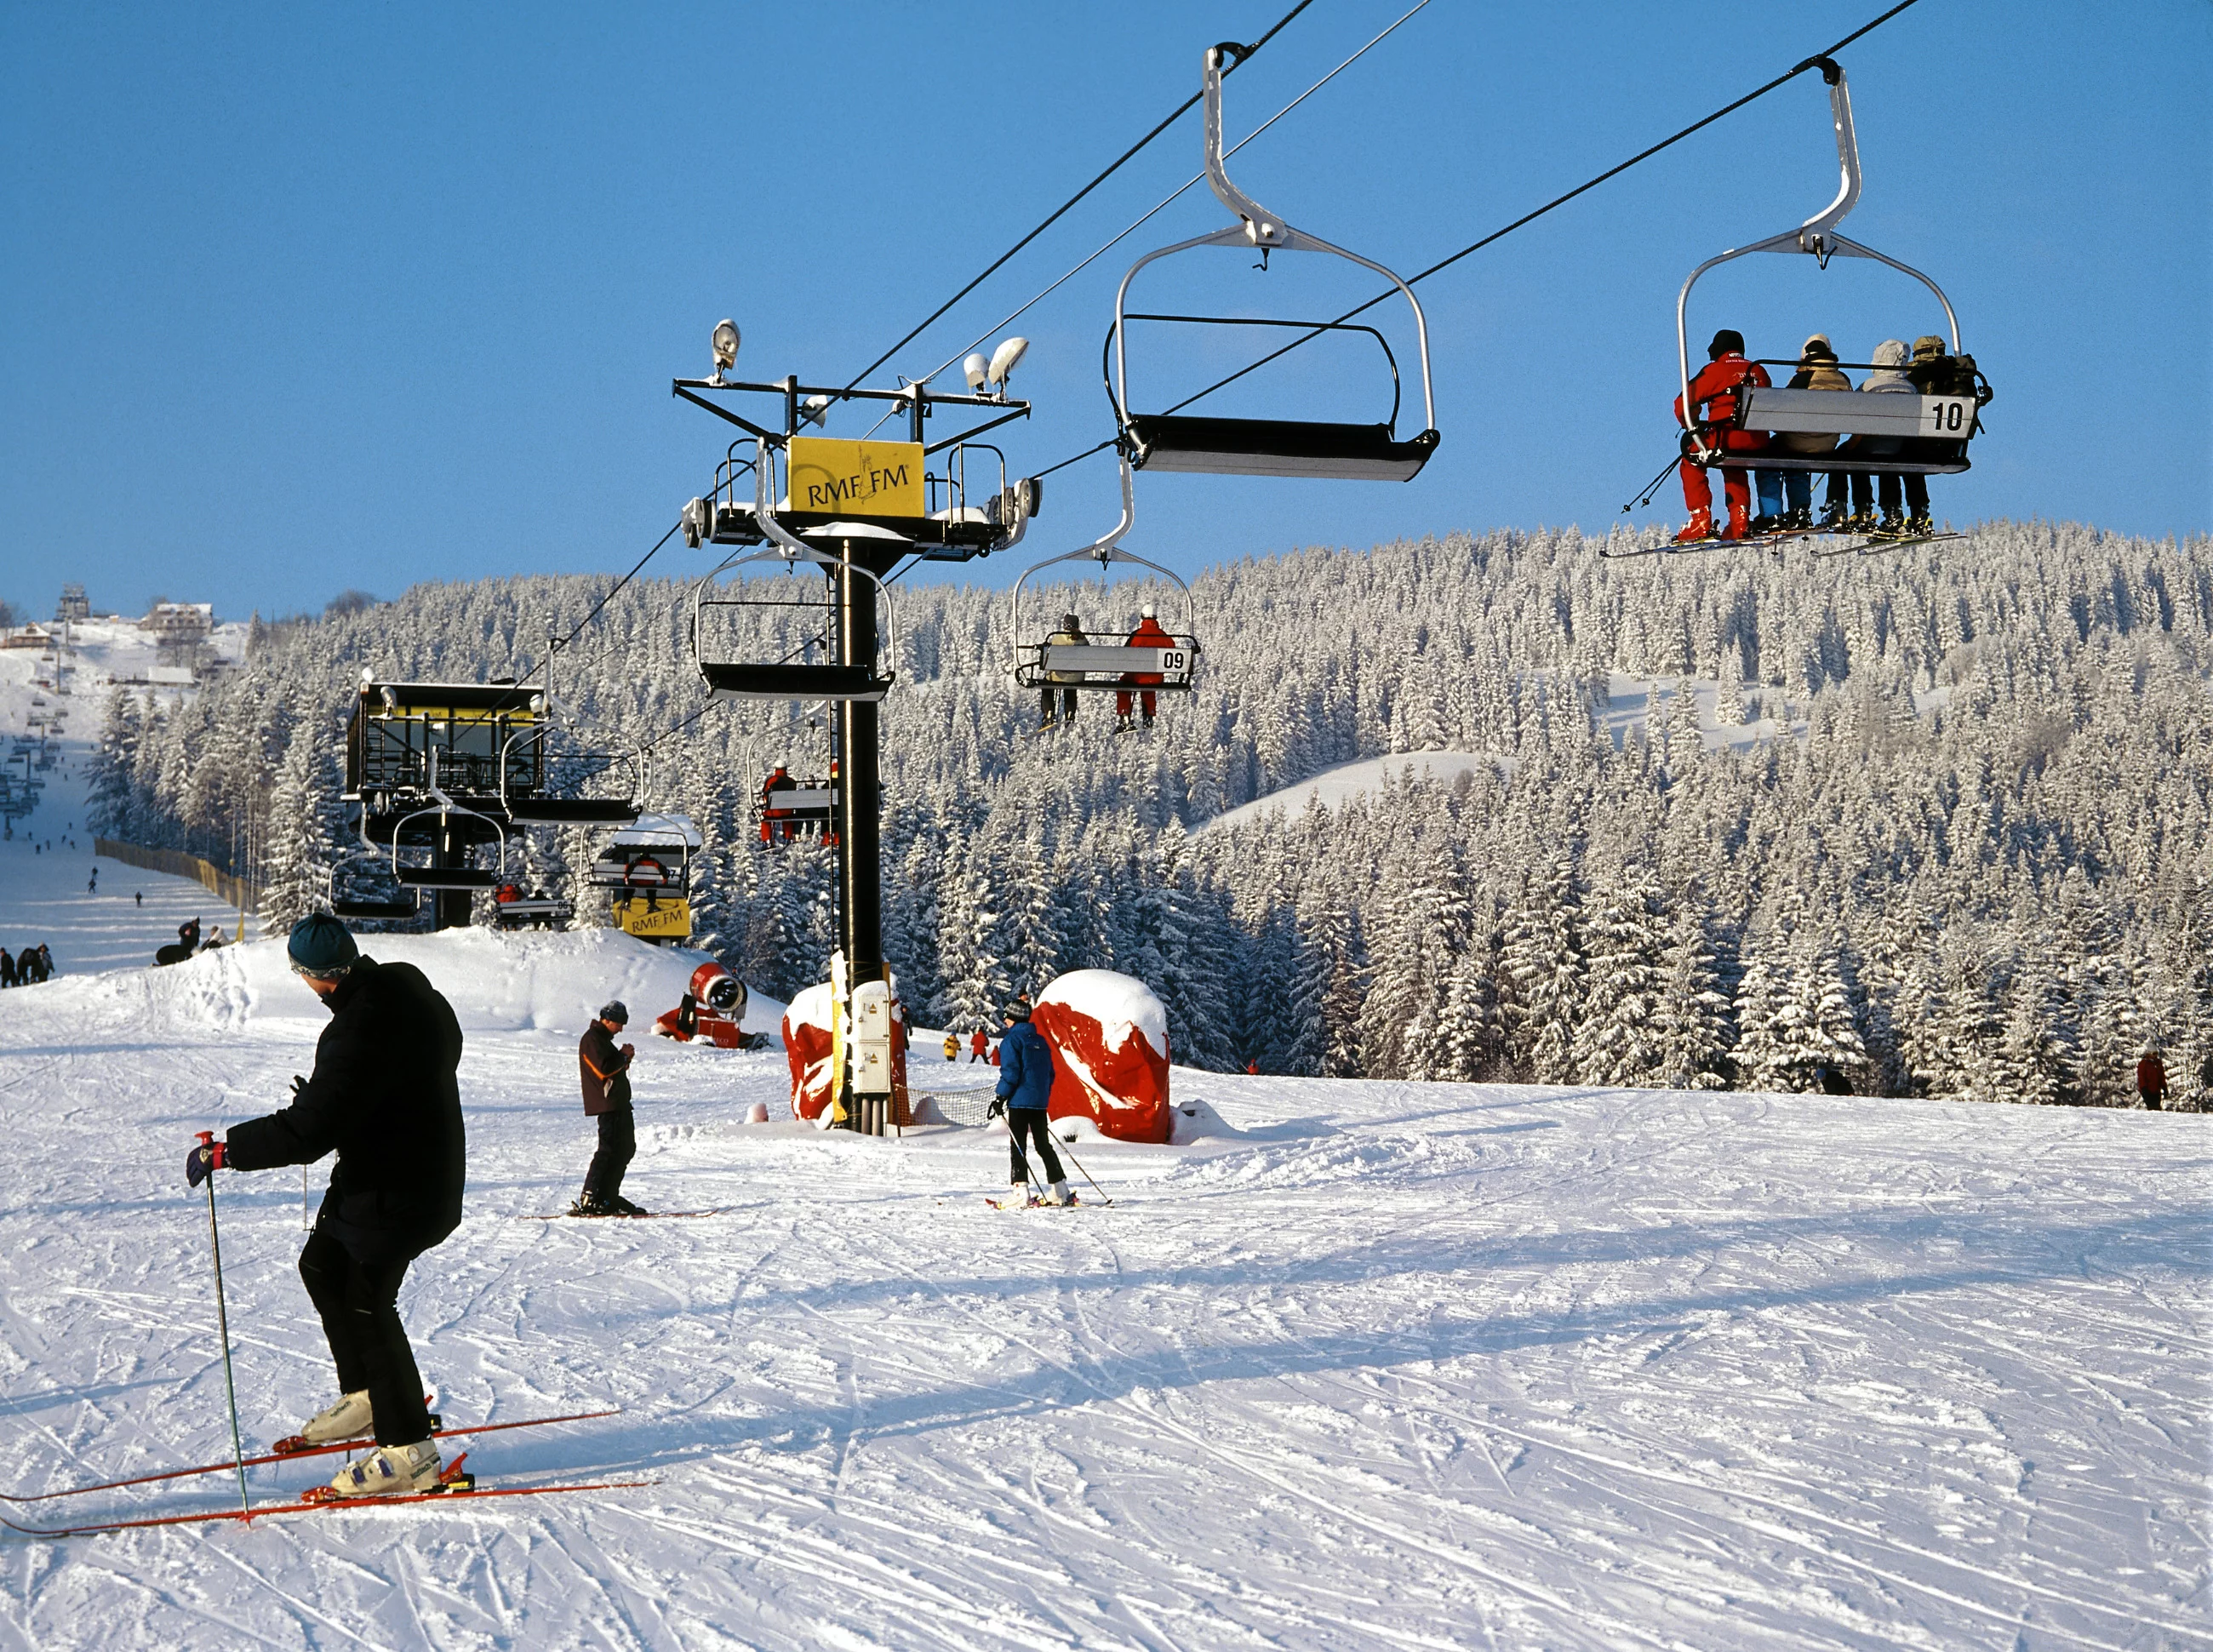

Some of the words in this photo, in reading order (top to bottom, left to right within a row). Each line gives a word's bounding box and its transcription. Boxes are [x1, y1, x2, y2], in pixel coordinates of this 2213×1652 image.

[923, 403, 930, 416] 7
[1932, 402, 1964, 432] 10
[808, 474, 861, 508] RMF
[870, 464, 909, 494] FM
[1164, 651, 1184, 669] 09
[558, 900, 569, 910] 06
[632, 915, 659, 933] RMF
[663, 910, 683, 925] FM
